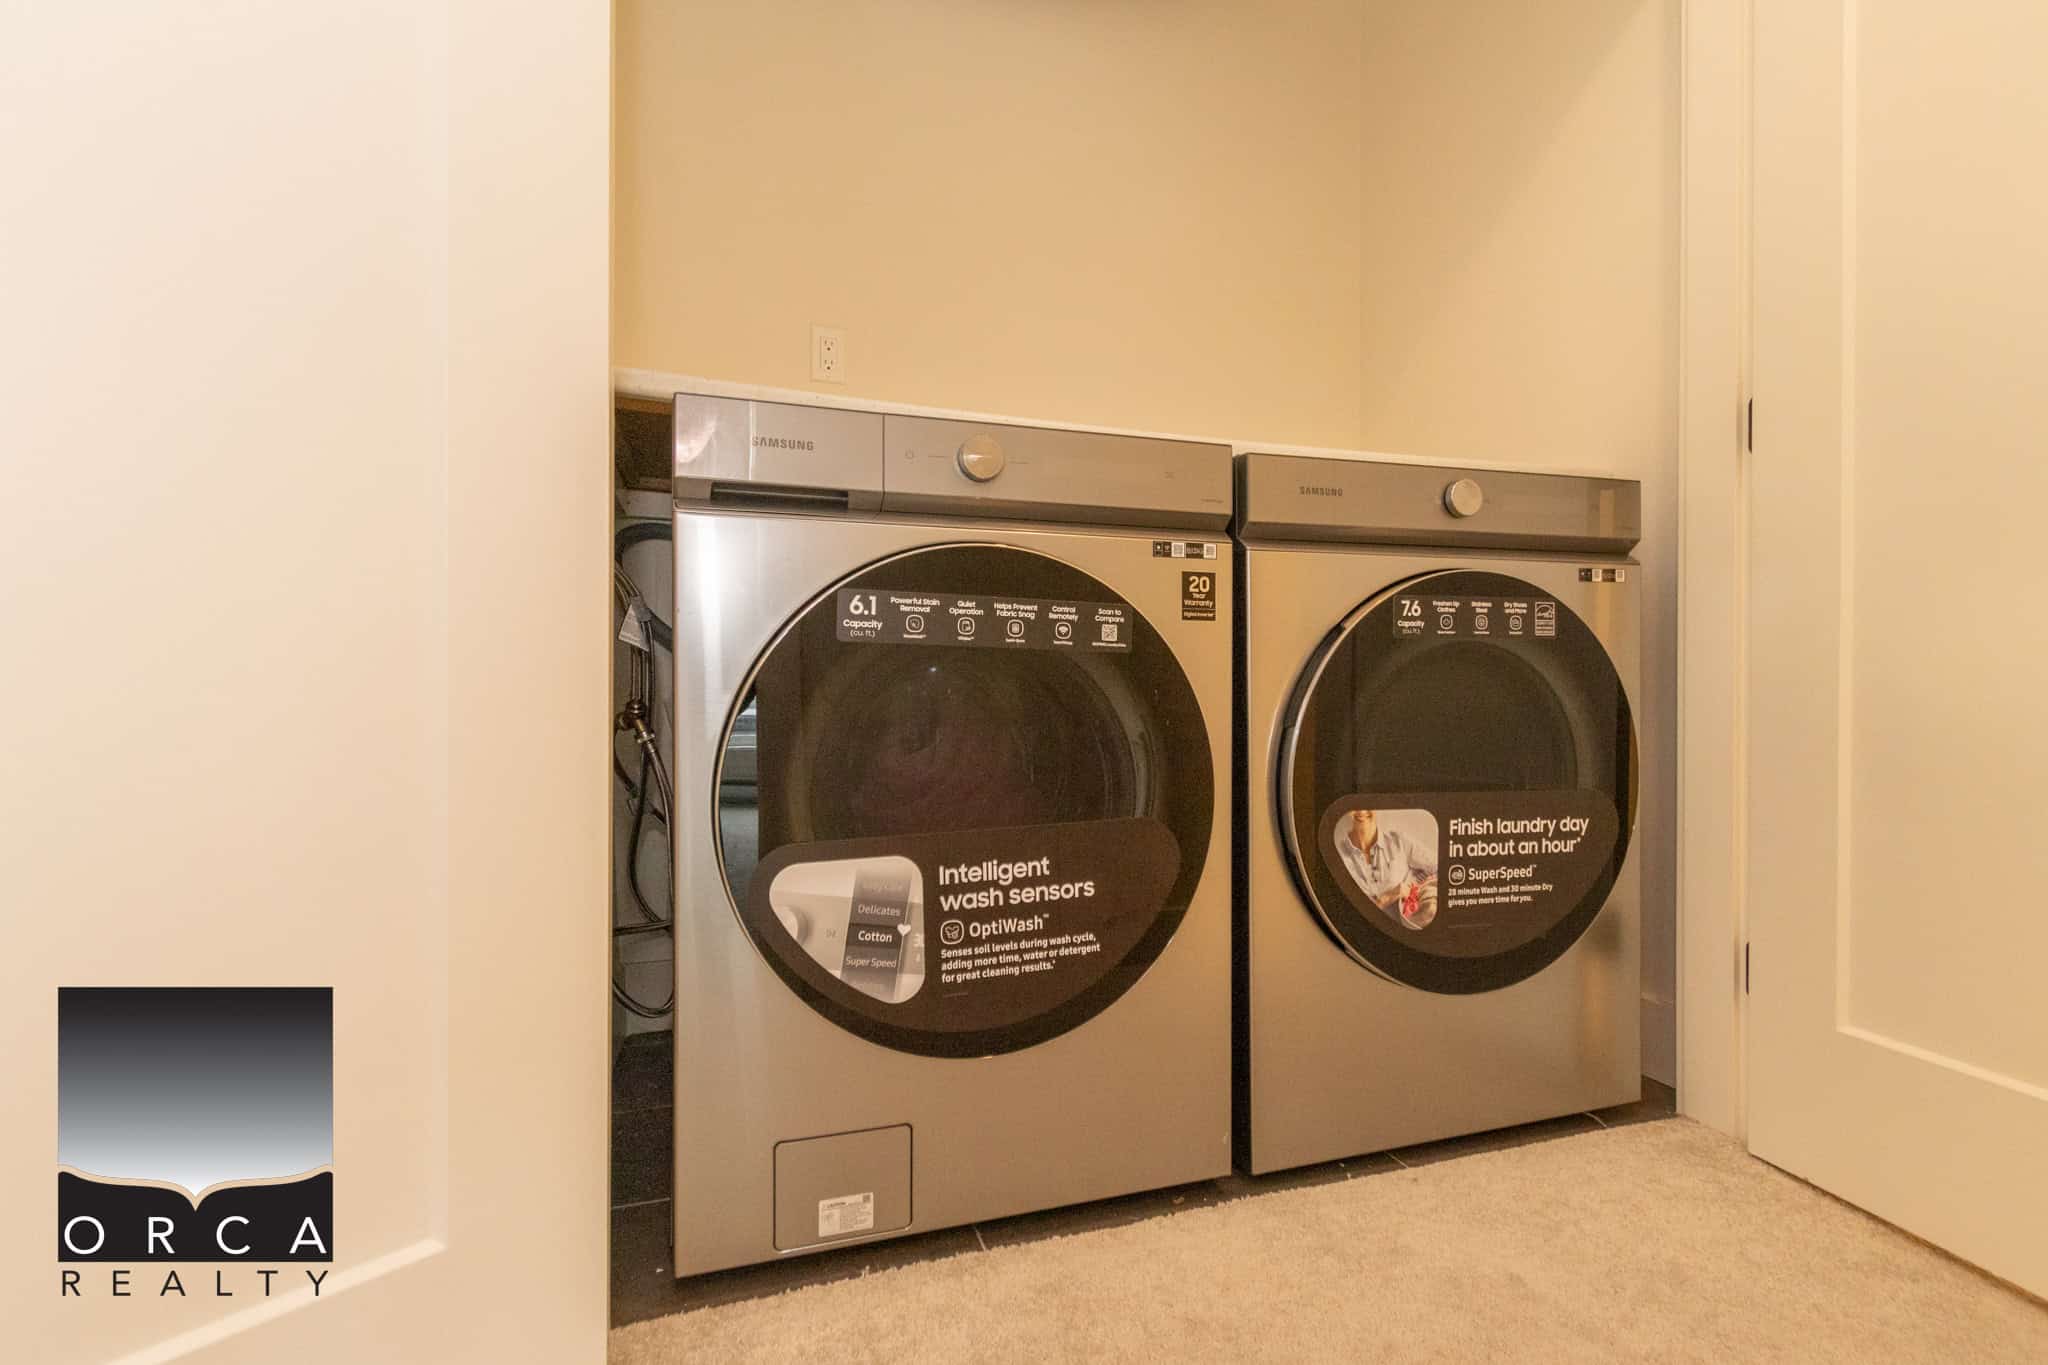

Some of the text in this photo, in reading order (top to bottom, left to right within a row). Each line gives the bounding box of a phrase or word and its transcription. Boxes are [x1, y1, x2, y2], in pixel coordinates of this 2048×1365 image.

[752, 436, 814, 451] SAMSUNG
[1300, 486, 1343, 497] SAMSUNG
[1189, 576, 1210, 593] 20
[849, 594, 877, 616] 6.1
[890, 596, 940, 606] Powerful Stain
[957, 600, 976, 608] Quiet
[994, 602, 1038, 612] Helps Prevent
[1184, 599, 1213, 609] Warranty
[900, 605, 931, 613] Removal
[949, 607, 984, 616] Operation
[997, 610, 1036, 620] Fabric Snag
[1052, 605, 1076, 614] Control
[1098, 608, 1122, 616] Scan to
[1401, 600, 1421, 617] 7.6
[1049, 612, 1079, 623] Remotely
[1095, 615, 1125, 624] Compare
[843, 619, 883, 630] Capacity
[1397, 620, 1425, 629] Capacity
[1449, 816, 1590, 838] Finish laundry day
[1449, 840, 1463, 858] in
[1466, 839, 1515, 857] about
[1518, 841, 1538, 855] an
[939, 856, 1050, 886] Intelligent
[940, 880, 1096, 912] wash sensors
[1457, 887, 1480, 896] minute
[1480, 886, 1498, 894] Wash
[1498, 885, 1511, 893] and
[1519, 884, 1541, 892] minute
[1541, 883, 1553, 893] Dry
[1448, 894, 1533, 908] gives you more time for you.
[858, 903, 900, 917] Delicates
[858, 930, 893, 943] Cotton
[941, 931, 1097, 959] Senses soil levels during wash cycle,
[846, 956, 897, 969] Super Speed
[941, 943, 1101, 971] adding more time, water or detergent
[942, 973, 956, 983] for
[956, 969, 981, 983] great
[982, 964, 1020, 978] cleaning
